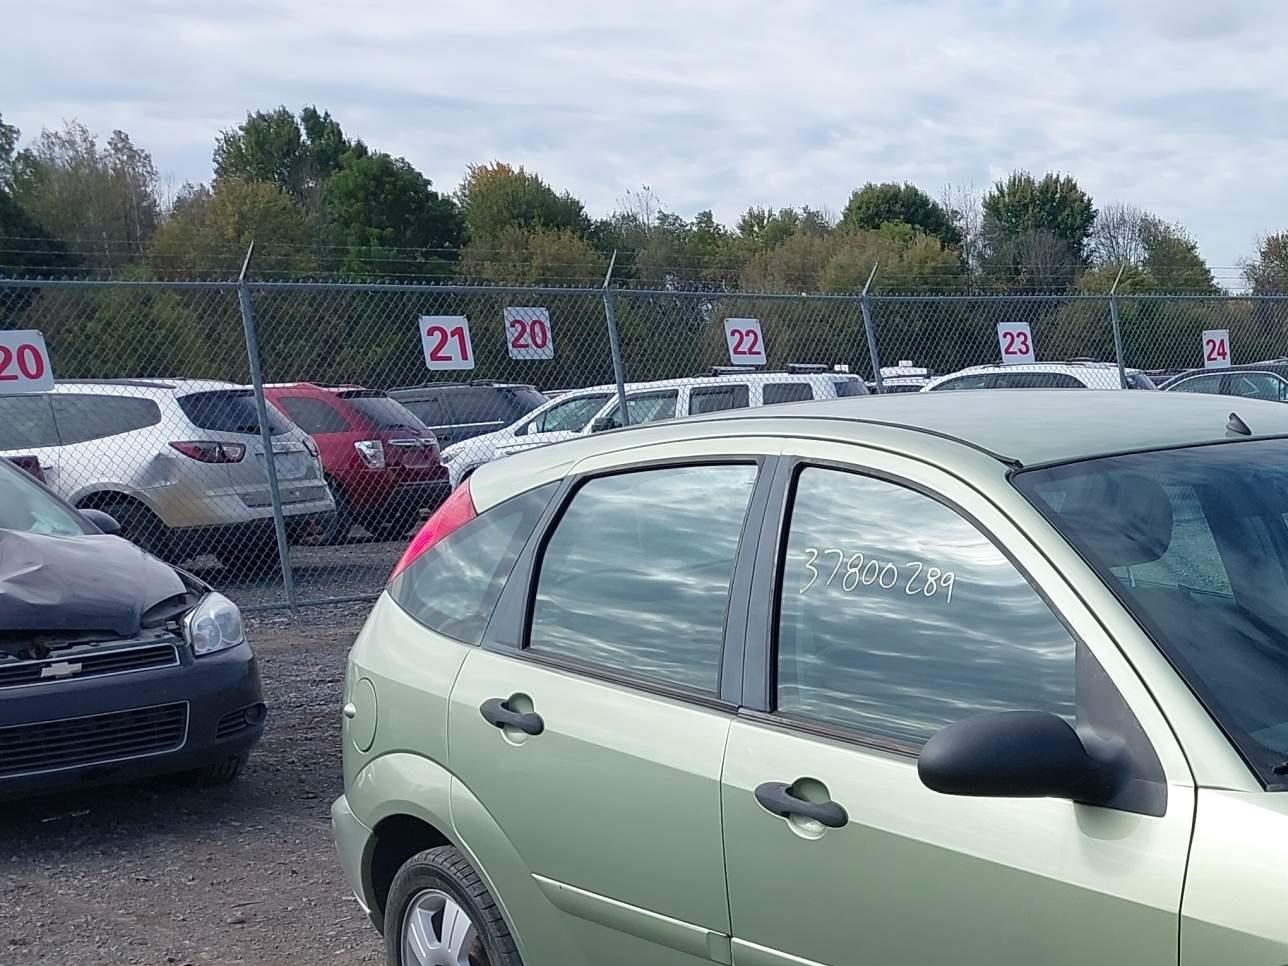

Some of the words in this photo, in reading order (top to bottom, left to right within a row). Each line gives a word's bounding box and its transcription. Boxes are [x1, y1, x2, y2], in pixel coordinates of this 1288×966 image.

[427, 325, 468, 361] 21
[510, 319, 547, 349] 20
[730, 329, 761, 355] 22
[1002, 331, 1030, 355] 23
[0, 344, 44, 380] 20
[1206, 338, 1227, 361] 24
[799, 548, 955, 604] 37800289
